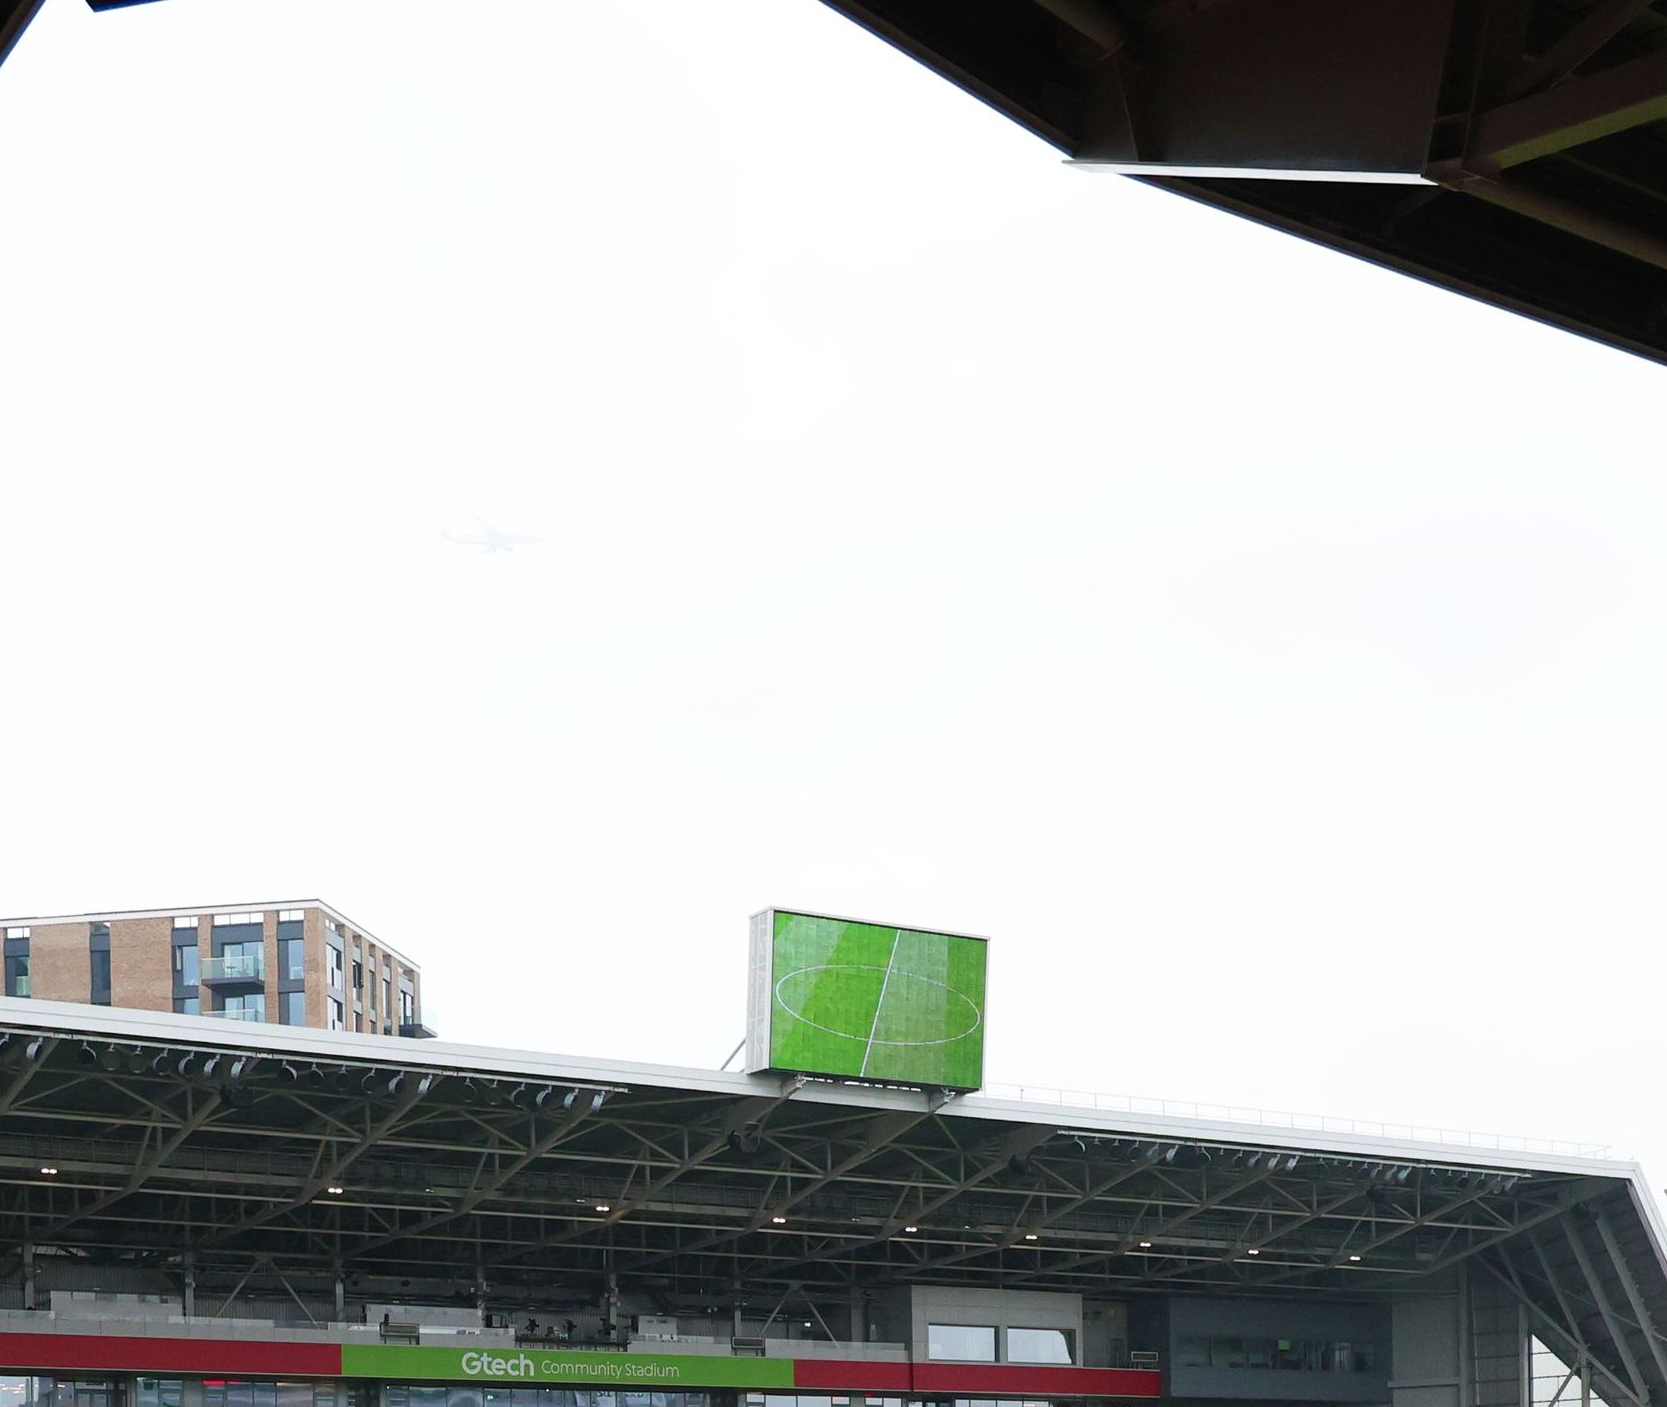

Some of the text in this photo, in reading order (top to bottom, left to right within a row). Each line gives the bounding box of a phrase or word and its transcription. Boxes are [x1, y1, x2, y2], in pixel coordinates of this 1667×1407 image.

[461, 1351, 680, 1378] Gtech Community Stadium
